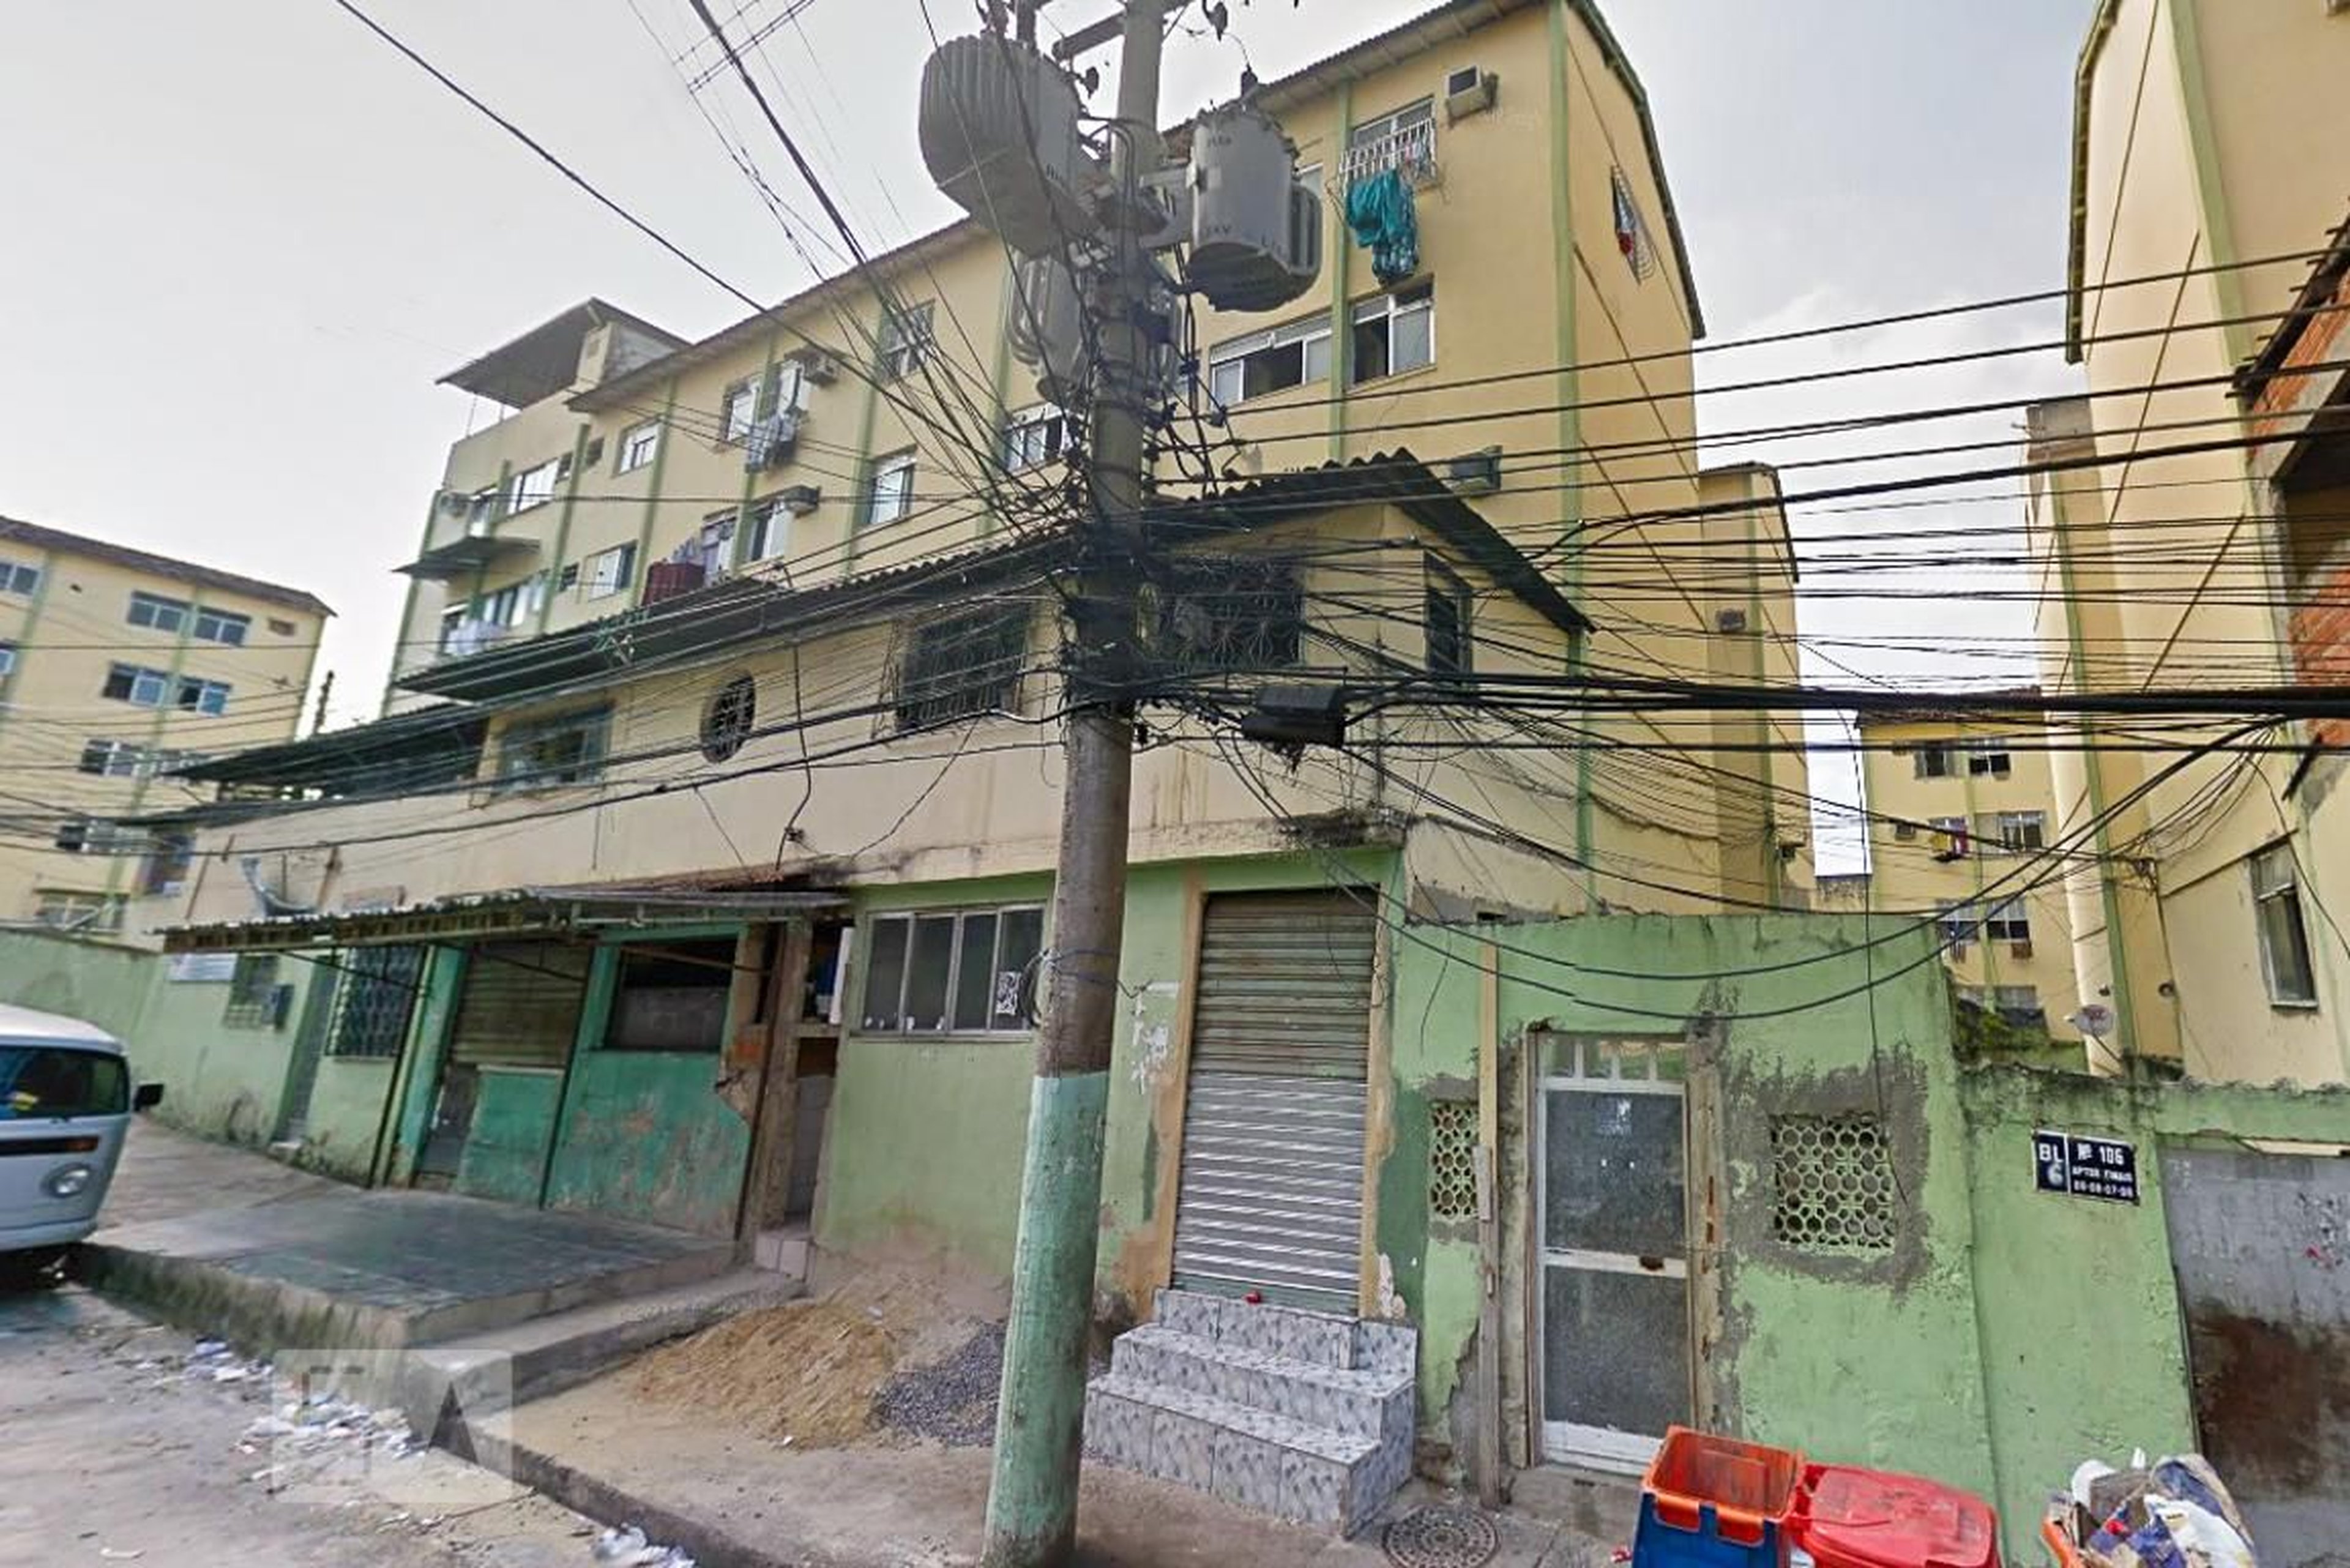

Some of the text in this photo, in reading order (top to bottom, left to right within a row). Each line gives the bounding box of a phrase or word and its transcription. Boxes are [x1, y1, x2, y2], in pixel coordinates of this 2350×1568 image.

[2039, 1143, 2063, 1163] BL
[2099, 1146, 2124, 1165] 106
[2048, 1163, 2063, 1185] 6
